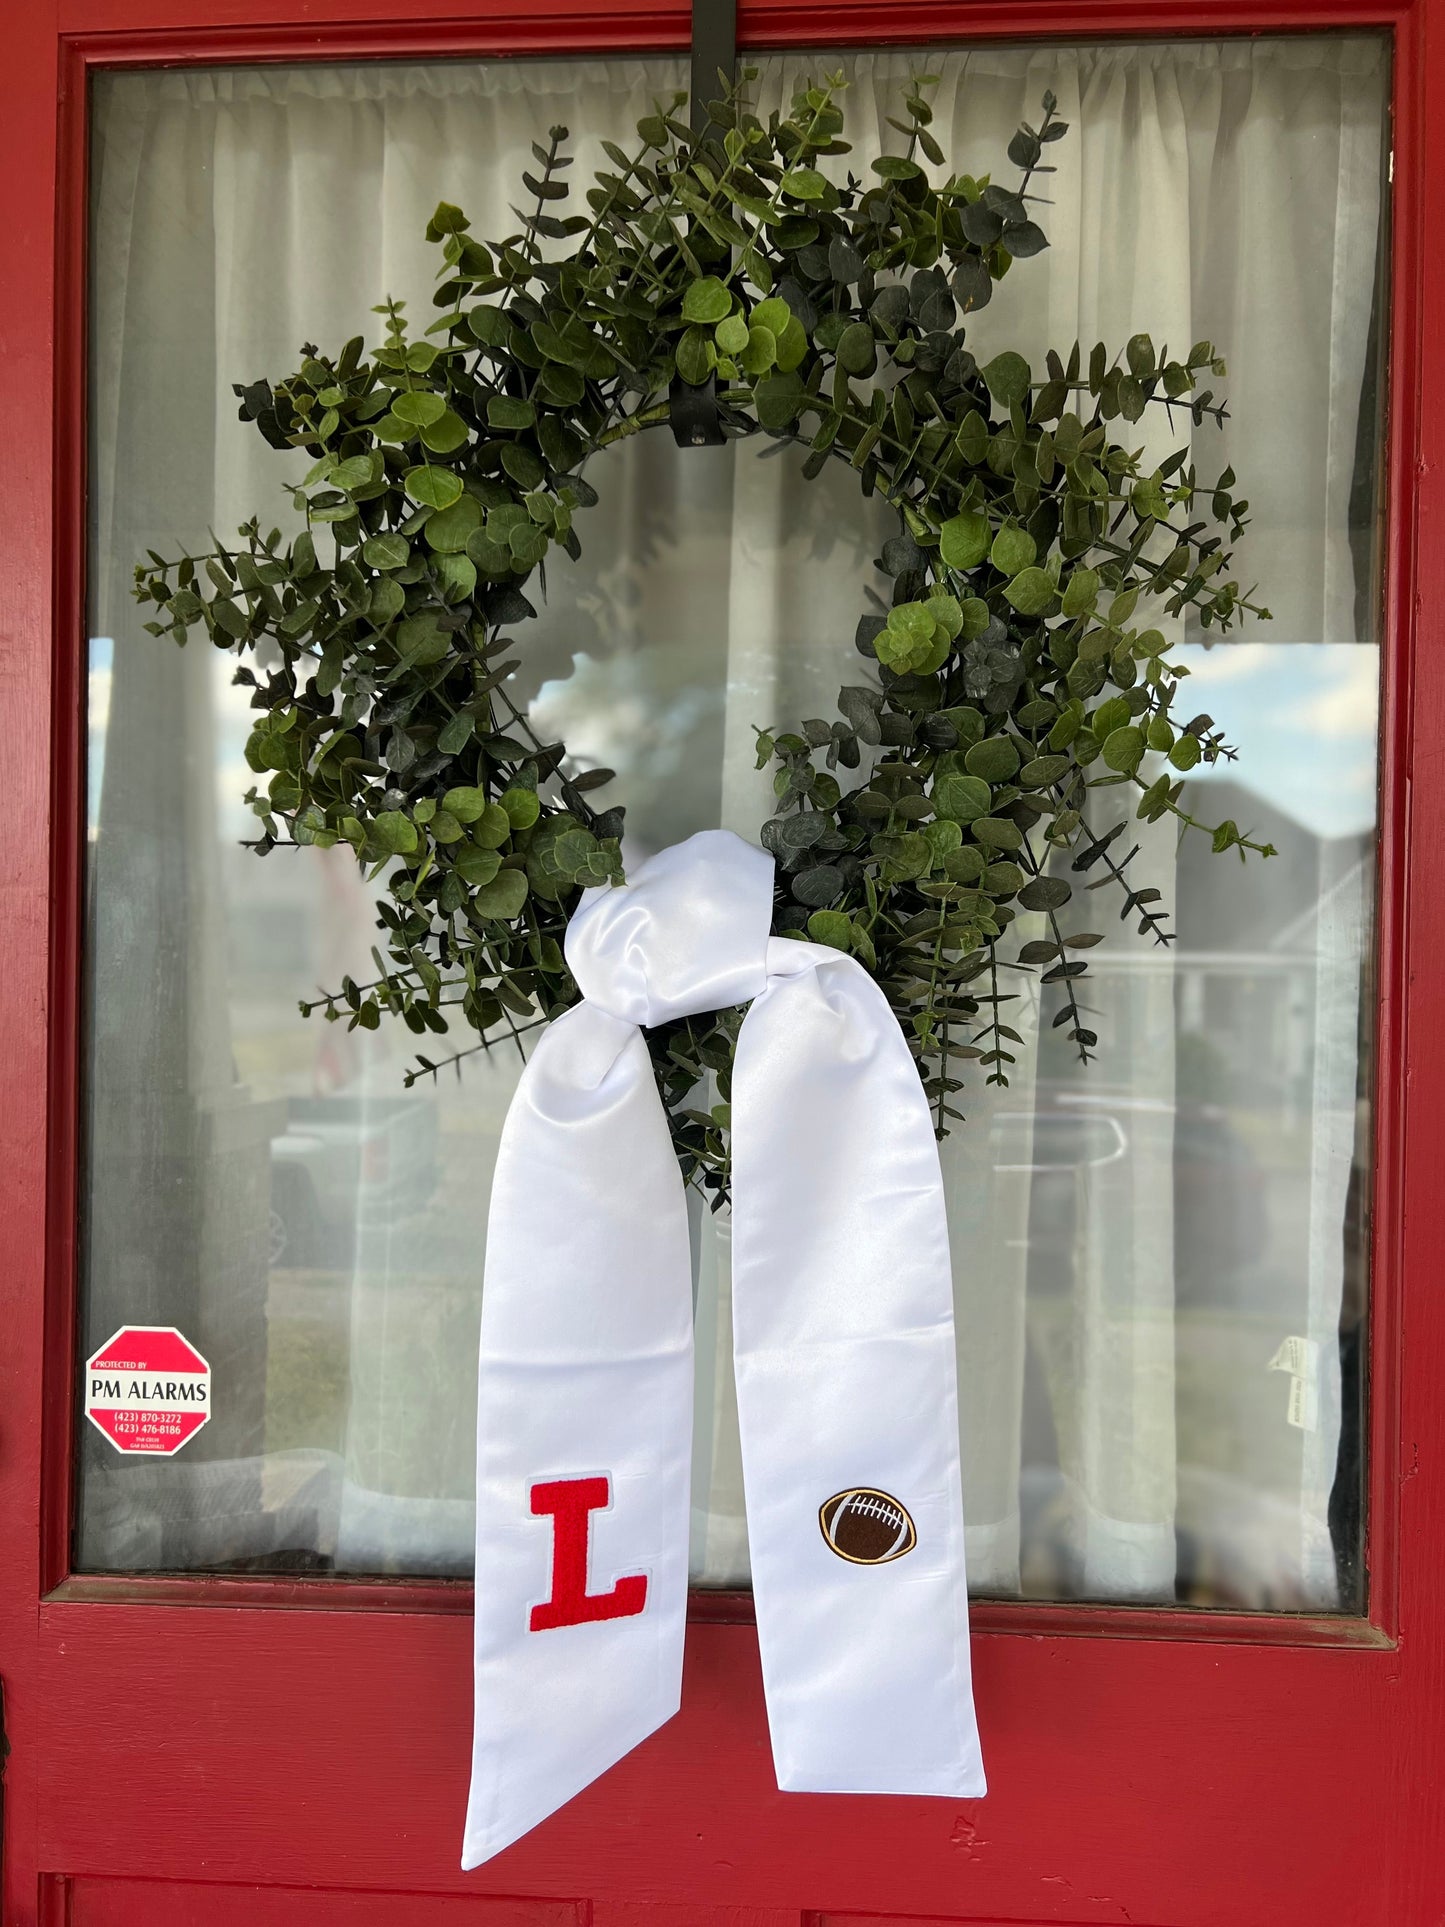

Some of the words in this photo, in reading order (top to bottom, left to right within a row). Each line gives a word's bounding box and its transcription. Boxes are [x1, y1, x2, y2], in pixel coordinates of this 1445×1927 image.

[95, 1360, 136, 1369] PROTECTED
[138, 1361, 147, 1370] BY
[92, 1379, 121, 1398] PM
[128, 1381, 207, 1402] ALARMS
[114, 1412, 139, 1422] (423)
[141, 1413, 182, 1424] 870-3272
[114, 1423, 139, 1433] (423)
[141, 1424, 181, 1435] 476-8186
[529, 1475, 649, 1633] L
